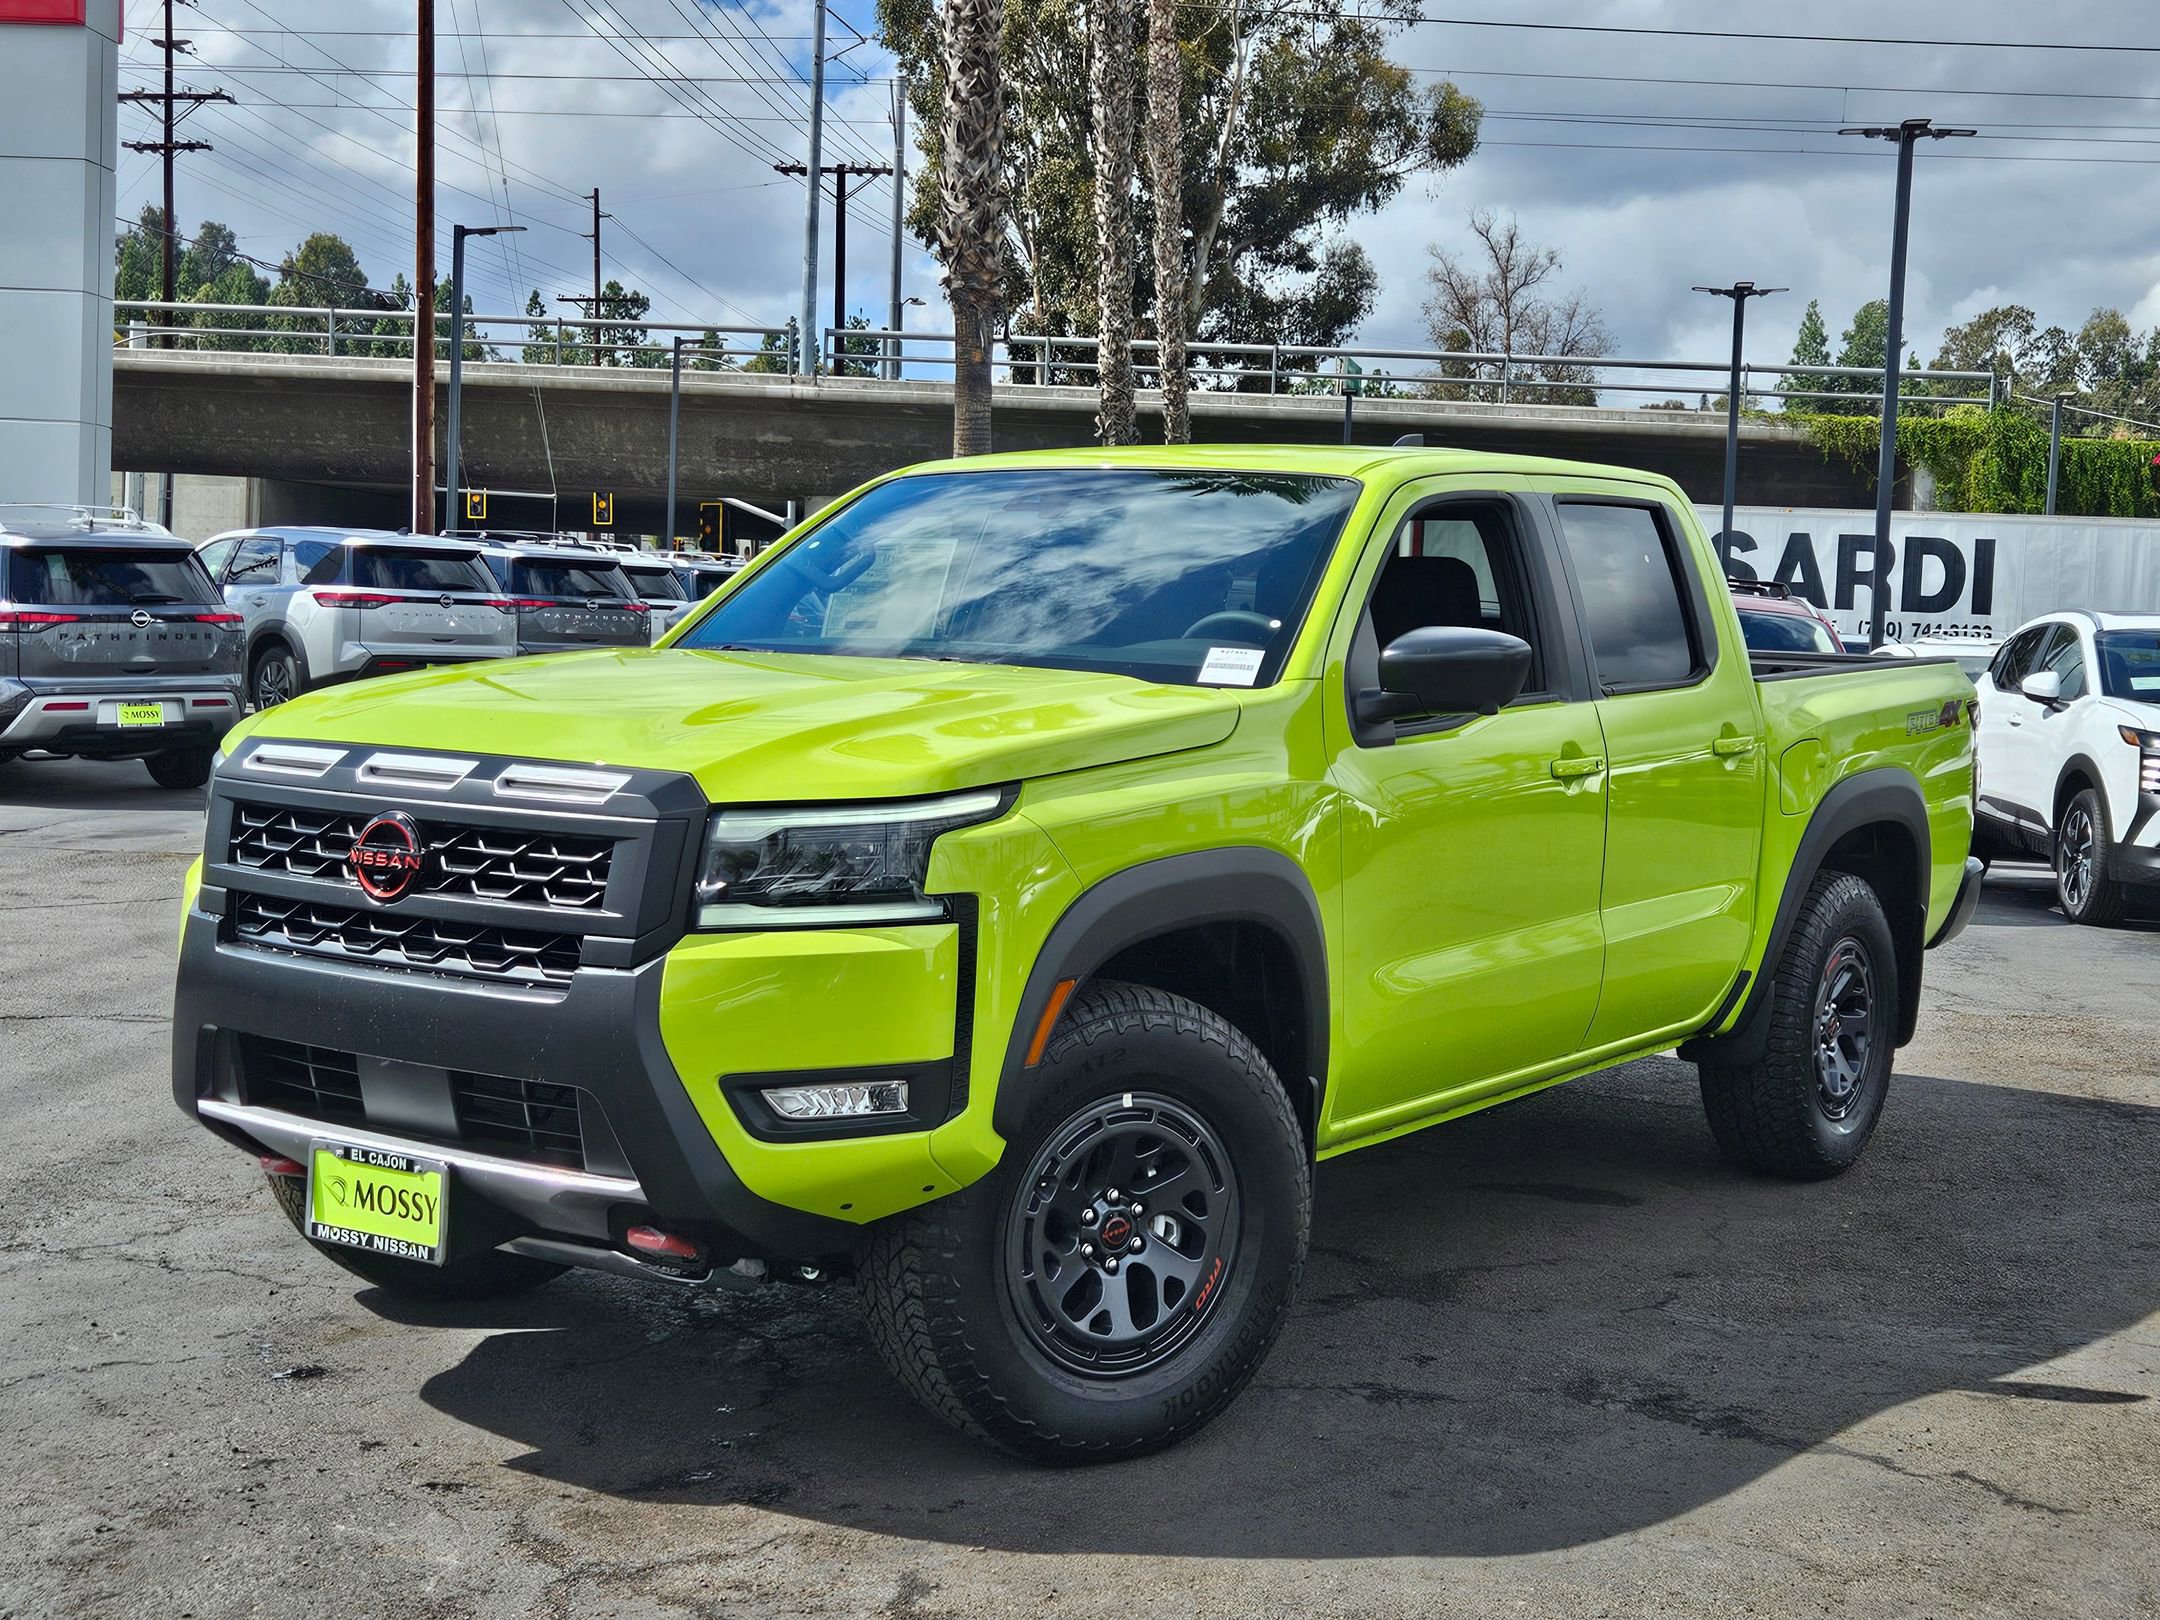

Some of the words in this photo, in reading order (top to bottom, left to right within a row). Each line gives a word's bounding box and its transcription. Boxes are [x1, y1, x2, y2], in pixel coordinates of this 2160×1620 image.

[59, 633, 213, 641] PATHFINDER
[1858, 620, 1902, 639] (70)
[350, 848, 420, 870] NISSAN
[351, 1149, 365, 1162] EL
[369, 1152, 407, 1170] CAJON
[353, 1179, 438, 1225] MOSSY
[317, 1224, 369, 1246] MOSSY
[374, 1235, 429, 1260] NISSAN
